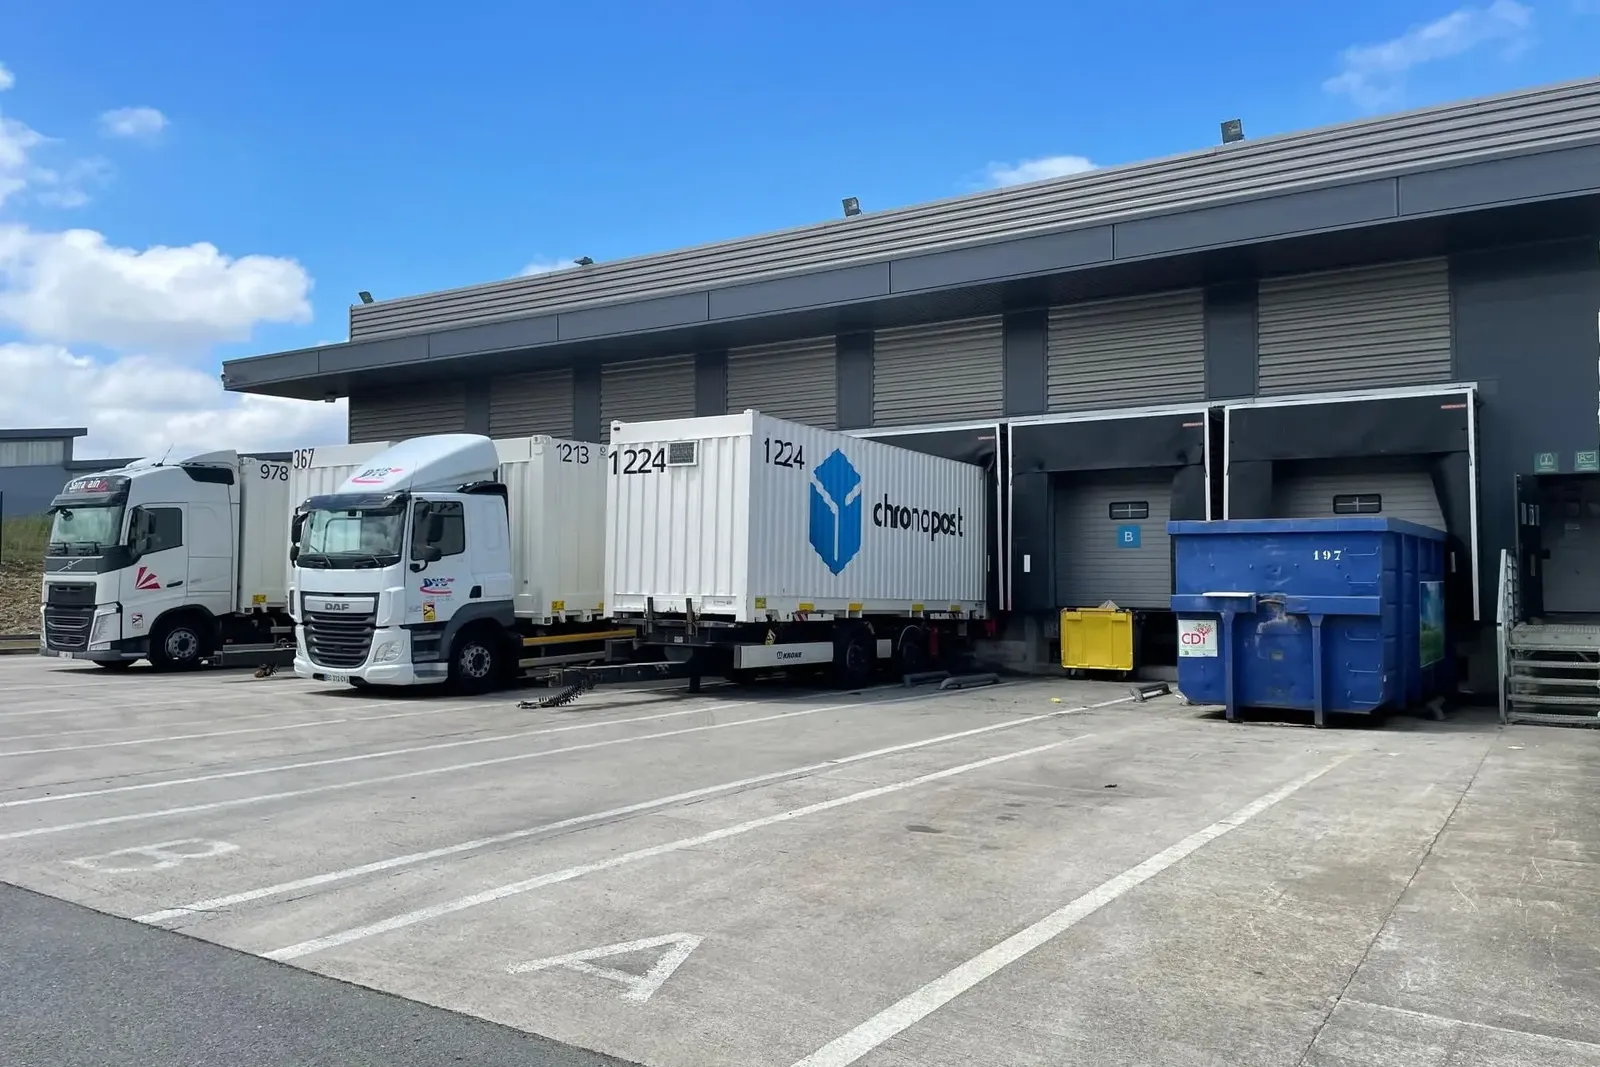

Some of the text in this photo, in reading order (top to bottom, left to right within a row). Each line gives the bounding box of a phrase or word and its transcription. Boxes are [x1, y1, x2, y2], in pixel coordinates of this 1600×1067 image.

[294, 448, 314, 469] 367
[556, 443, 589, 464] 1213
[608, 447, 666, 475] 1224
[764, 437, 805, 470] 1224
[260, 464, 289, 481] 978
[873, 493, 963, 542] chronopost
[1124, 531, 1134, 542] B
[1312, 550, 1342, 561] 197
[324, 603, 350, 611] DAF
[506, 931, 706, 1008] A
